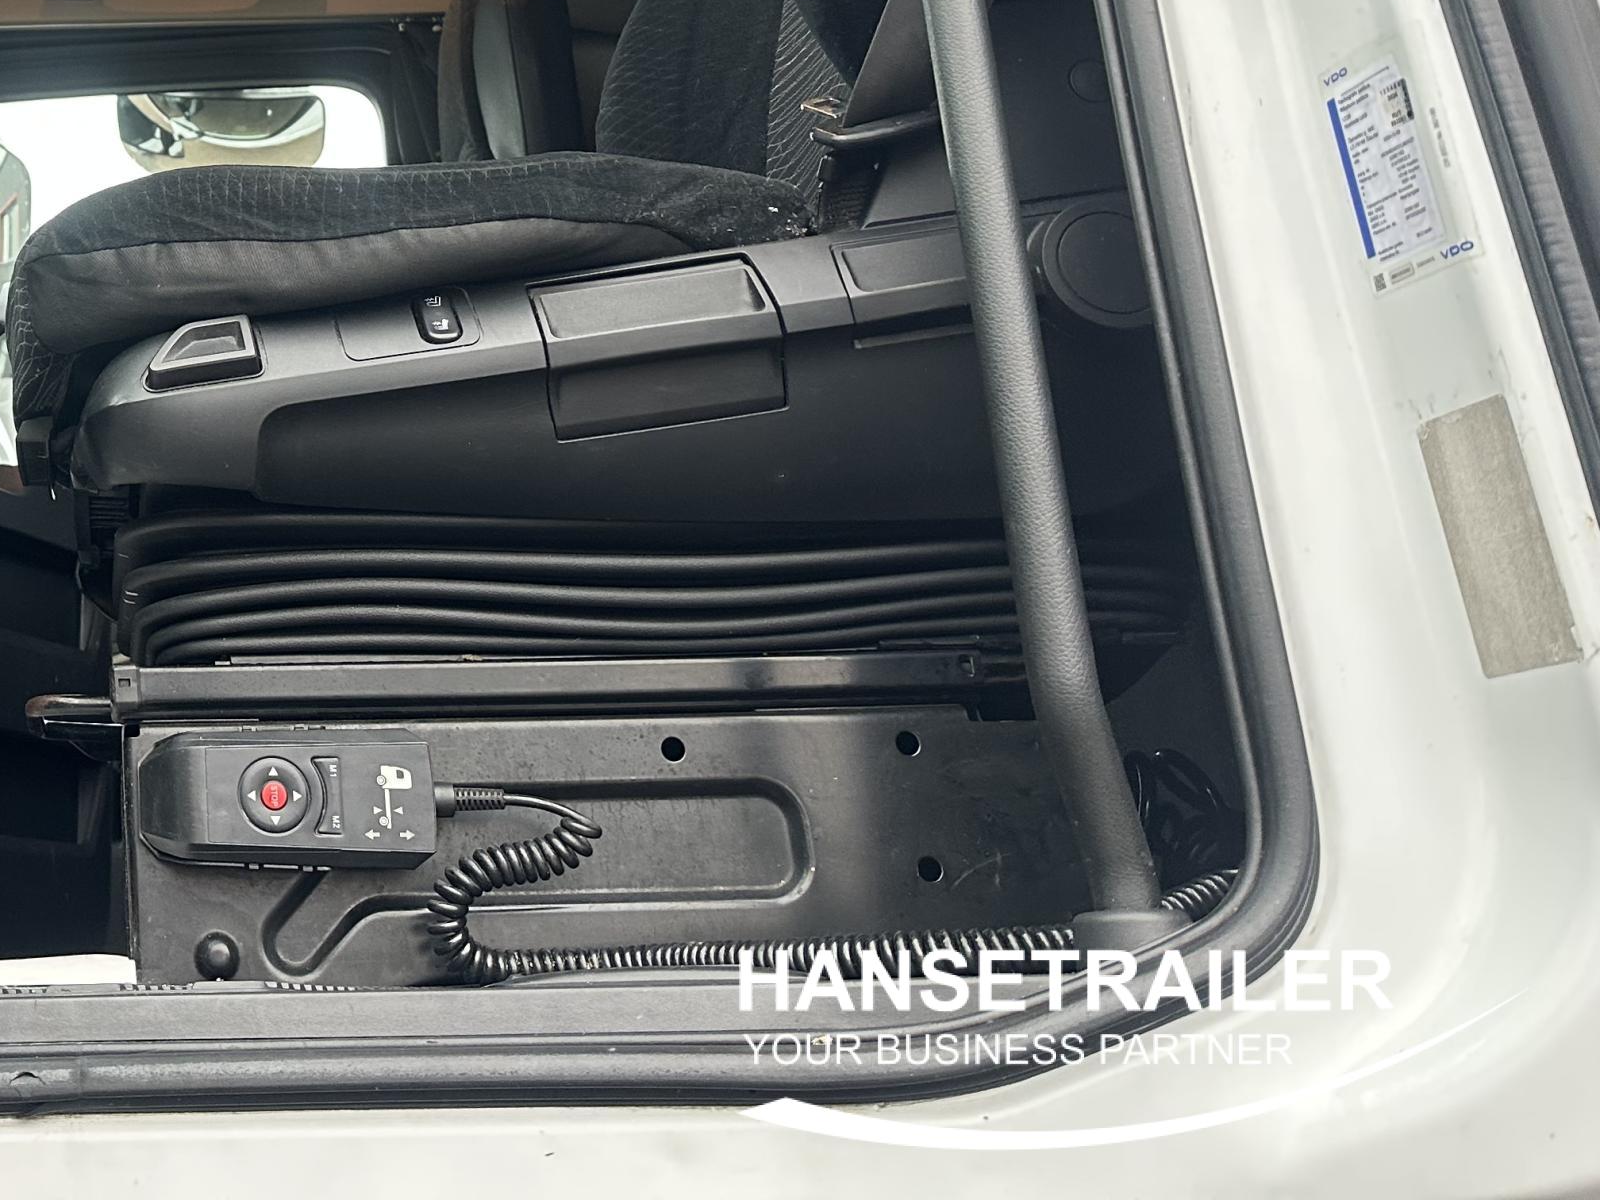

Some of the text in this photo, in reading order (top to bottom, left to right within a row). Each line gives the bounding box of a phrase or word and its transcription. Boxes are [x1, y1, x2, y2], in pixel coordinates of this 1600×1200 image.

[1324, 67, 1348, 87] VDO
[1440, 240, 1474, 260] VDO
[329, 764, 338, 777] M1
[270, 784, 278, 807] STOP
[332, 815, 341, 829] M2
